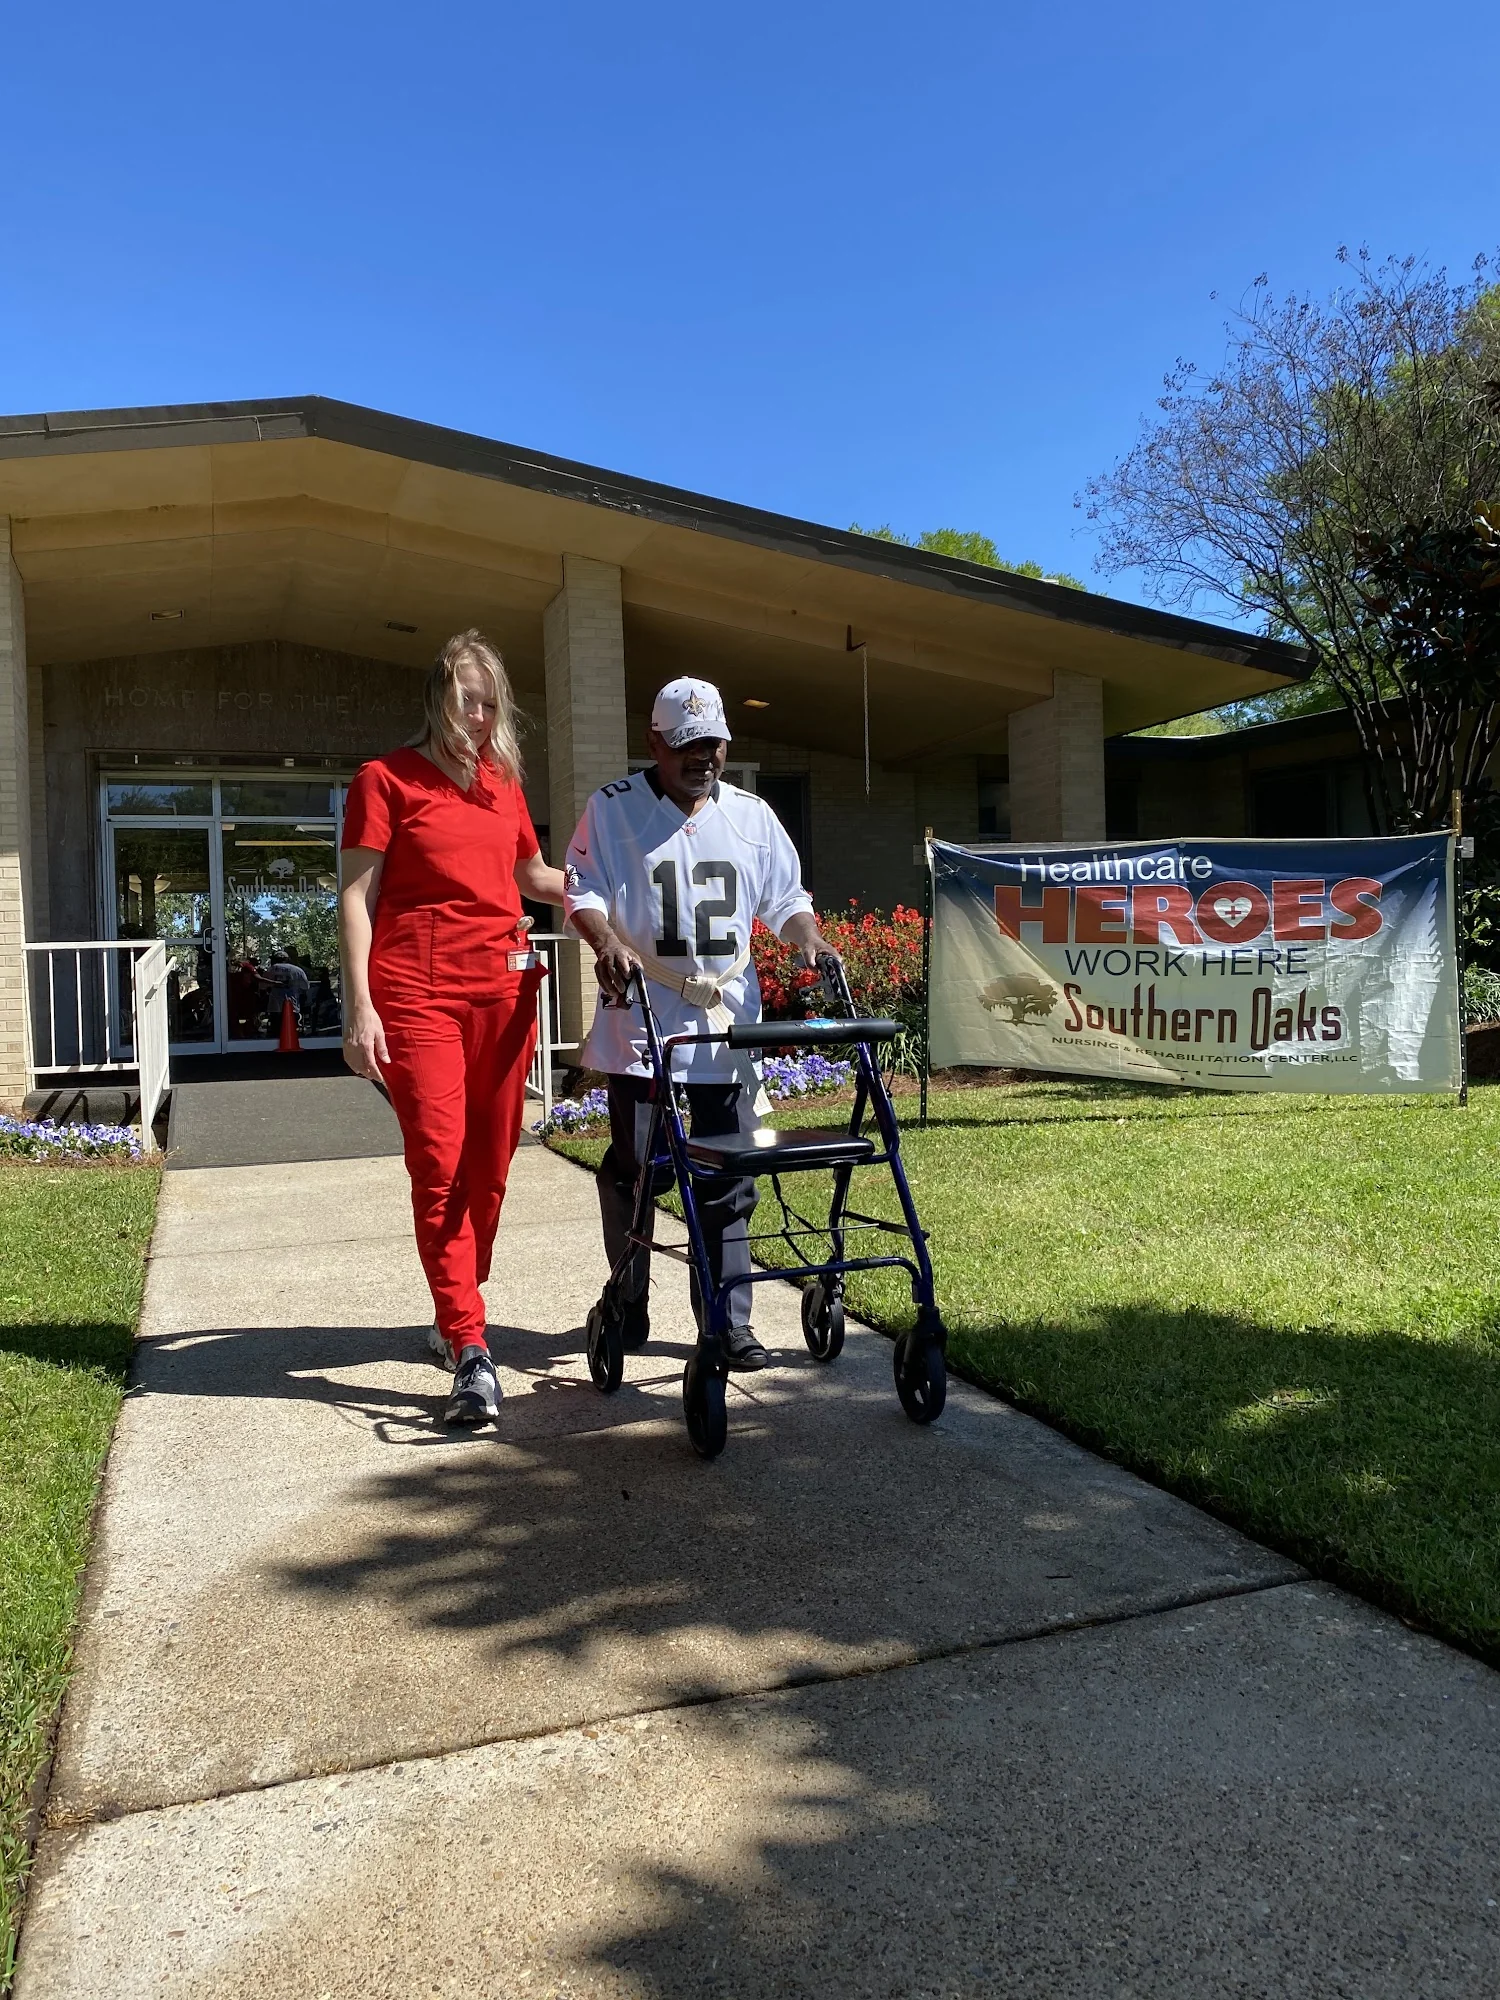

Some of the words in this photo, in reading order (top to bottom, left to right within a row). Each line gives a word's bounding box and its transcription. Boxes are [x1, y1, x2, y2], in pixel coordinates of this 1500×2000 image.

[104, 686, 196, 709] HOME
[217, 691, 274, 711] FOR
[293, 694, 350, 715] THE
[1020, 853, 1213, 882] Healthcare
[227, 875, 295, 901] Southern
[298, 875, 334, 901] Oak
[651, 859, 738, 957] 12
[994, 877, 1384, 945] HEROES
[1064, 949, 1188, 977] WORK
[1202, 947, 1308, 976] HERE
[1063, 982, 1238, 1043] Southern
[1250, 987, 1342, 1051] Oaks
[1052, 1037, 1119, 1050] NURSING
[1135, 1047, 1263, 1063] REHABILITATION
